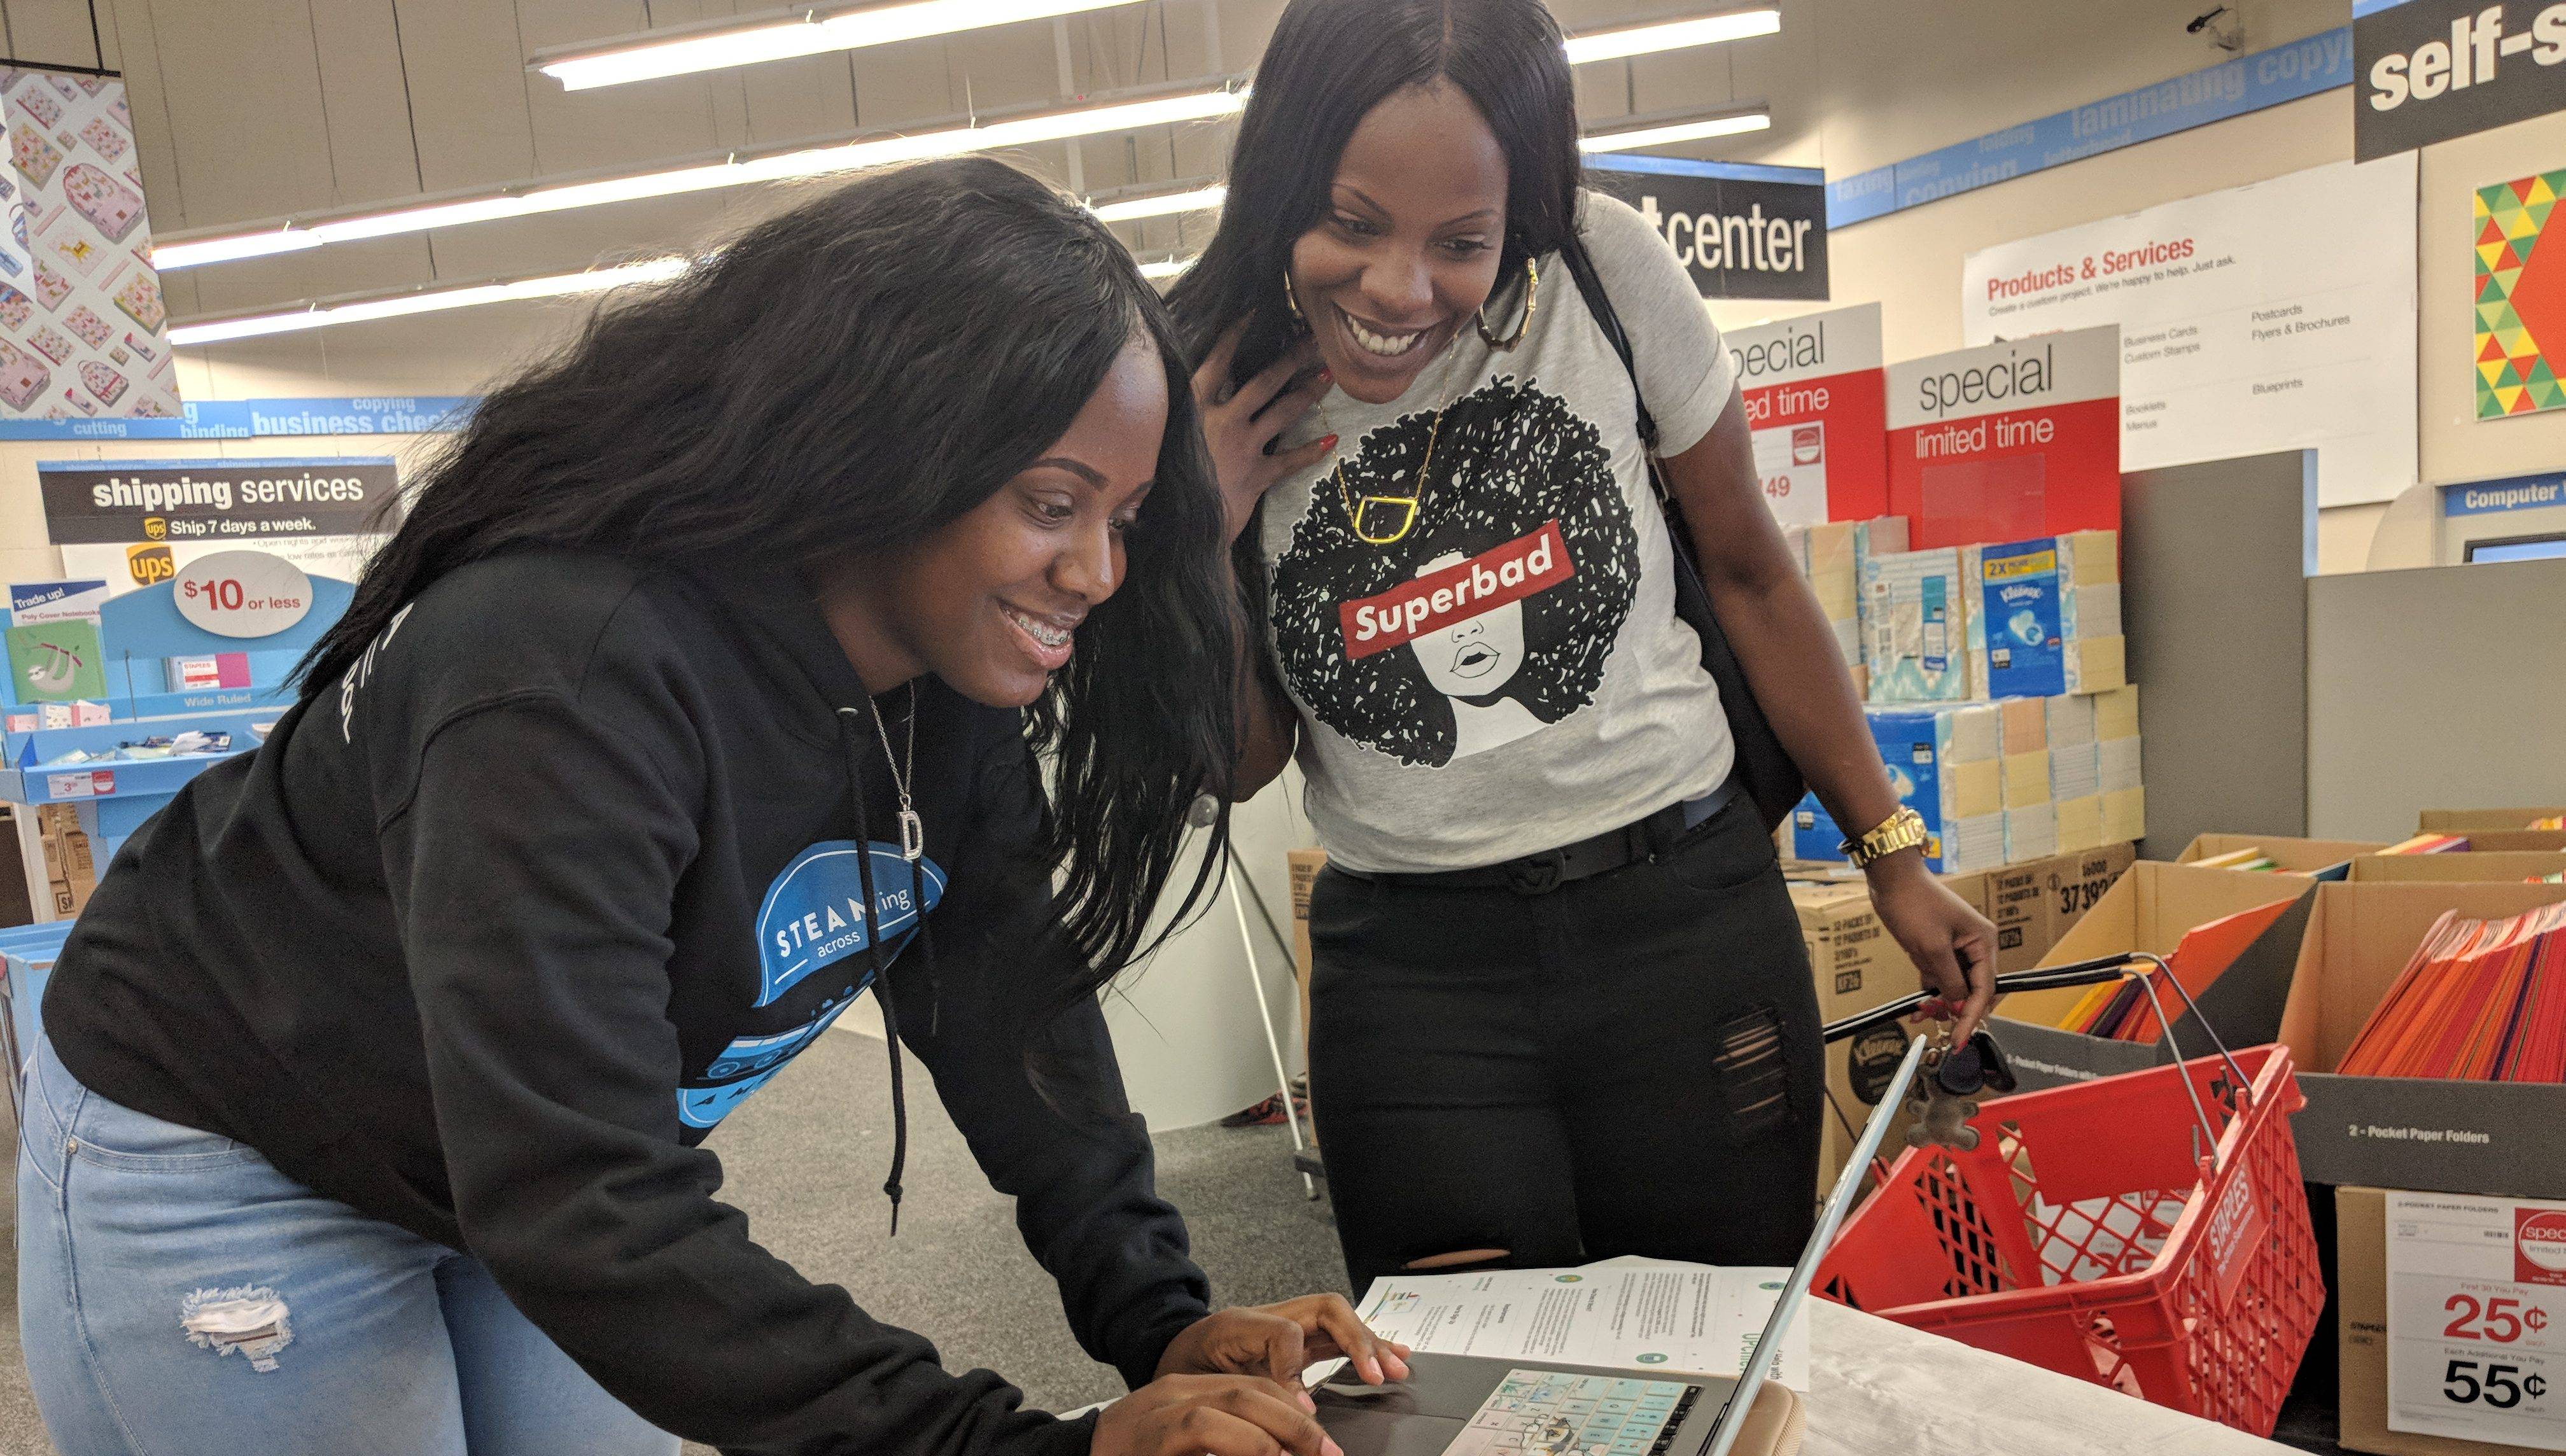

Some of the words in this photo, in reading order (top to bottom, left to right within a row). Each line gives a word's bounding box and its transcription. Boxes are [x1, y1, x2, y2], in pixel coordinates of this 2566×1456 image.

[2072, 64, 2246, 139] laminating
[1988, 263, 2075, 301] Products
[2080, 256, 2096, 280] &
[2102, 238, 2194, 275] Services
[1989, 303, 2017, 317] Create
[2027, 295, 2058, 309] custom
[2122, 273, 2151, 288] happy
[2154, 270, 2164, 281] to
[2192, 260, 2215, 274] Just
[2251, 304, 2303, 322] Postcards
[2124, 332, 2166, 348] Business
[2169, 325, 2198, 339] Cards
[2251, 327, 2282, 342] Flyers
[2284, 324, 2292, 335] &
[2295, 315, 2351, 333] Brochures
[2124, 350, 2161, 365] Custom
[2163, 342, 2201, 358] Stamps
[1920, 343, 2052, 417] special
[2252, 379, 2304, 395] Blueprints
[353, 397, 416, 412] copying
[1777, 387, 1830, 416] time
[2126, 400, 2166, 414] Booklets
[73, 422, 127, 438] cutting
[251, 411, 374, 435] business
[1916, 419, 1986, 459] limited
[1995, 416, 2054, 448] time
[92, 477, 232, 512] shipping
[241, 473, 363, 504] services
[2465, 484, 2559, 509] Computer
[146, 521, 165, 535] ups
[171, 520, 206, 537] Ship
[208, 521, 216, 533] 7
[220, 518, 257, 536] days
[260, 521, 270, 532] a
[272, 516, 318, 531] week.
[130, 556, 175, 585] ups
[14, 594, 46, 609] Trade
[46, 587, 66, 600] up!
[184, 578, 244, 611] $10
[248, 599, 265, 610] or
[269, 596, 301, 609] less
[1356, 533, 1553, 642] Superbad
[185, 697, 214, 707] Wide
[217, 694, 252, 704] Ruled
[817, 929, 861, 958] across
[2349, 1124, 2358, 1137] 2
[2367, 1125, 2408, 1140] Pocket
[2409, 1127, 2444, 1142] Paper
[2446, 1129, 2490, 1144] Folders
[2210, 1170, 2249, 1260] STAPLES
[2463, 1206, 2500, 1214] FOLDERS
[2495, 1285, 2511, 1294] You
[2513, 1287, 2529, 1296] Pay
[2467, 1350, 2507, 1361] Additional
[2511, 1355, 2527, 1363] You
[2528, 1357, 2545, 1366] Pay
[2444, 1360, 2546, 1408] 55¢
